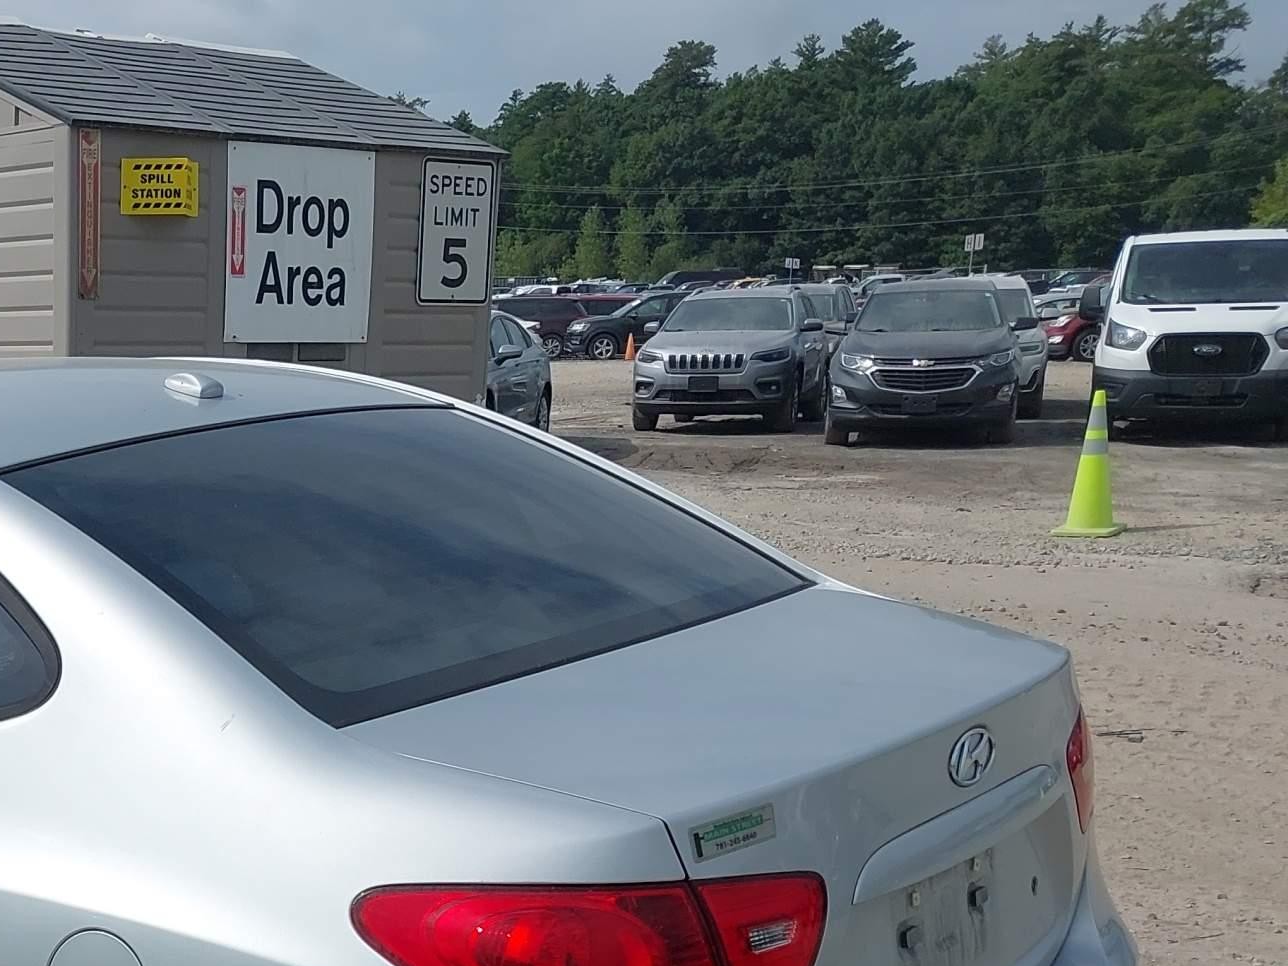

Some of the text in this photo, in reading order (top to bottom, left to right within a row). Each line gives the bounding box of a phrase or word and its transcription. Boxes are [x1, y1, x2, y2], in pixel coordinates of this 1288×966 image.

[140, 173, 174, 184] SPILL
[429, 174, 487, 196] SPEED
[131, 188, 181, 199] STATION
[256, 179, 350, 249] Drop
[433, 205, 480, 228] LIMIT
[440, 237, 468, 288] 5
[255, 251, 346, 306] Area
